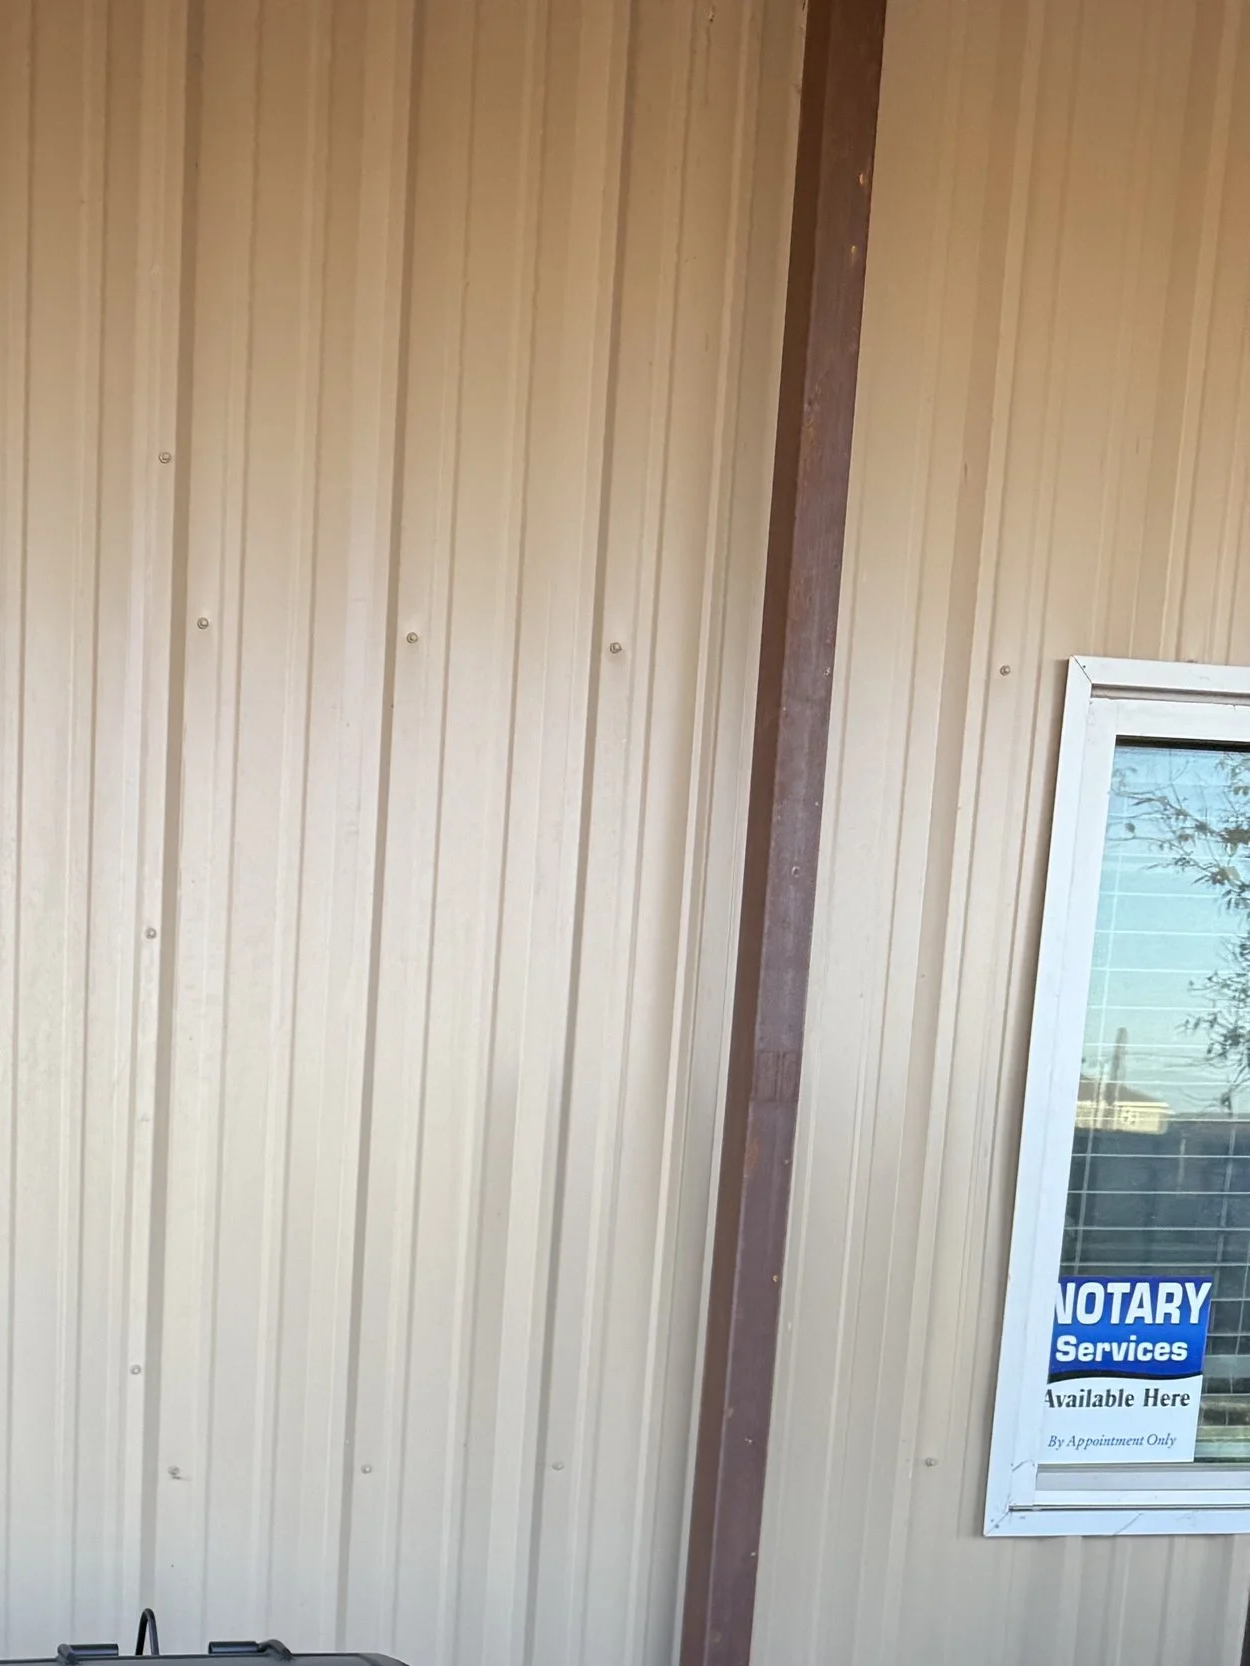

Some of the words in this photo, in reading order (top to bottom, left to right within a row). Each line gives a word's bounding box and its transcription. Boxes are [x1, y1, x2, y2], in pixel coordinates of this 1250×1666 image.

[1055, 1334, 1188, 1362] Services
[1044, 1388, 1135, 1408] Available
[1143, 1388, 1191, 1408] Here
[1047, 1434, 1065, 1449] By
[1066, 1433, 1145, 1450] Appointment
[1146, 1432, 1177, 1449] Only
